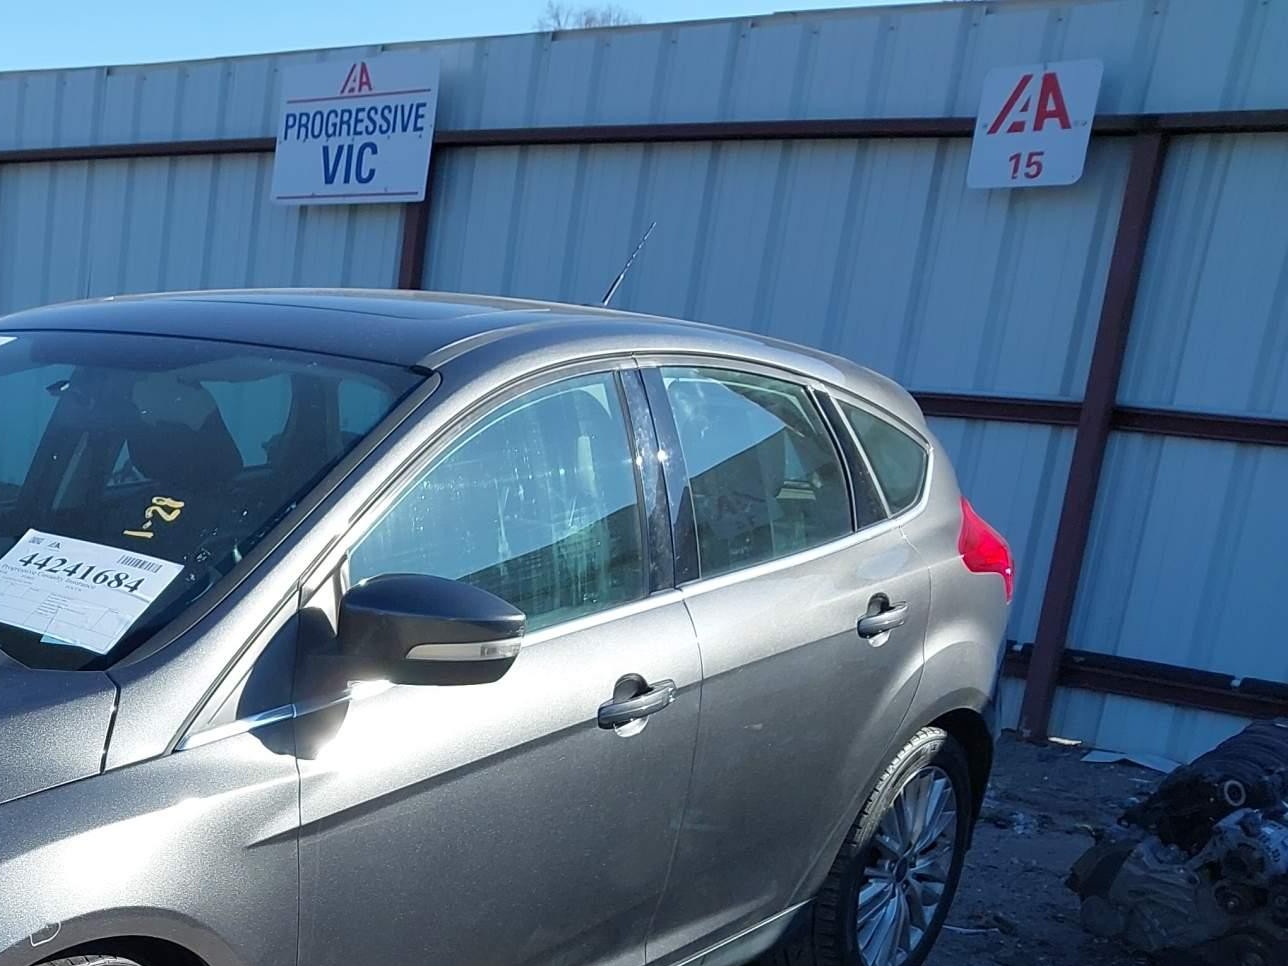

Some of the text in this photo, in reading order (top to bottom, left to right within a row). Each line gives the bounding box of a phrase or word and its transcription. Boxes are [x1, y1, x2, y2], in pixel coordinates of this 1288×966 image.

[284, 102, 427, 141] PROGRESSIVE
[321, 141, 379, 185] VIC
[1008, 150, 1045, 180] 15
[123, 496, 185, 539] 1-28
[18, 552, 146, 593] 44241684
